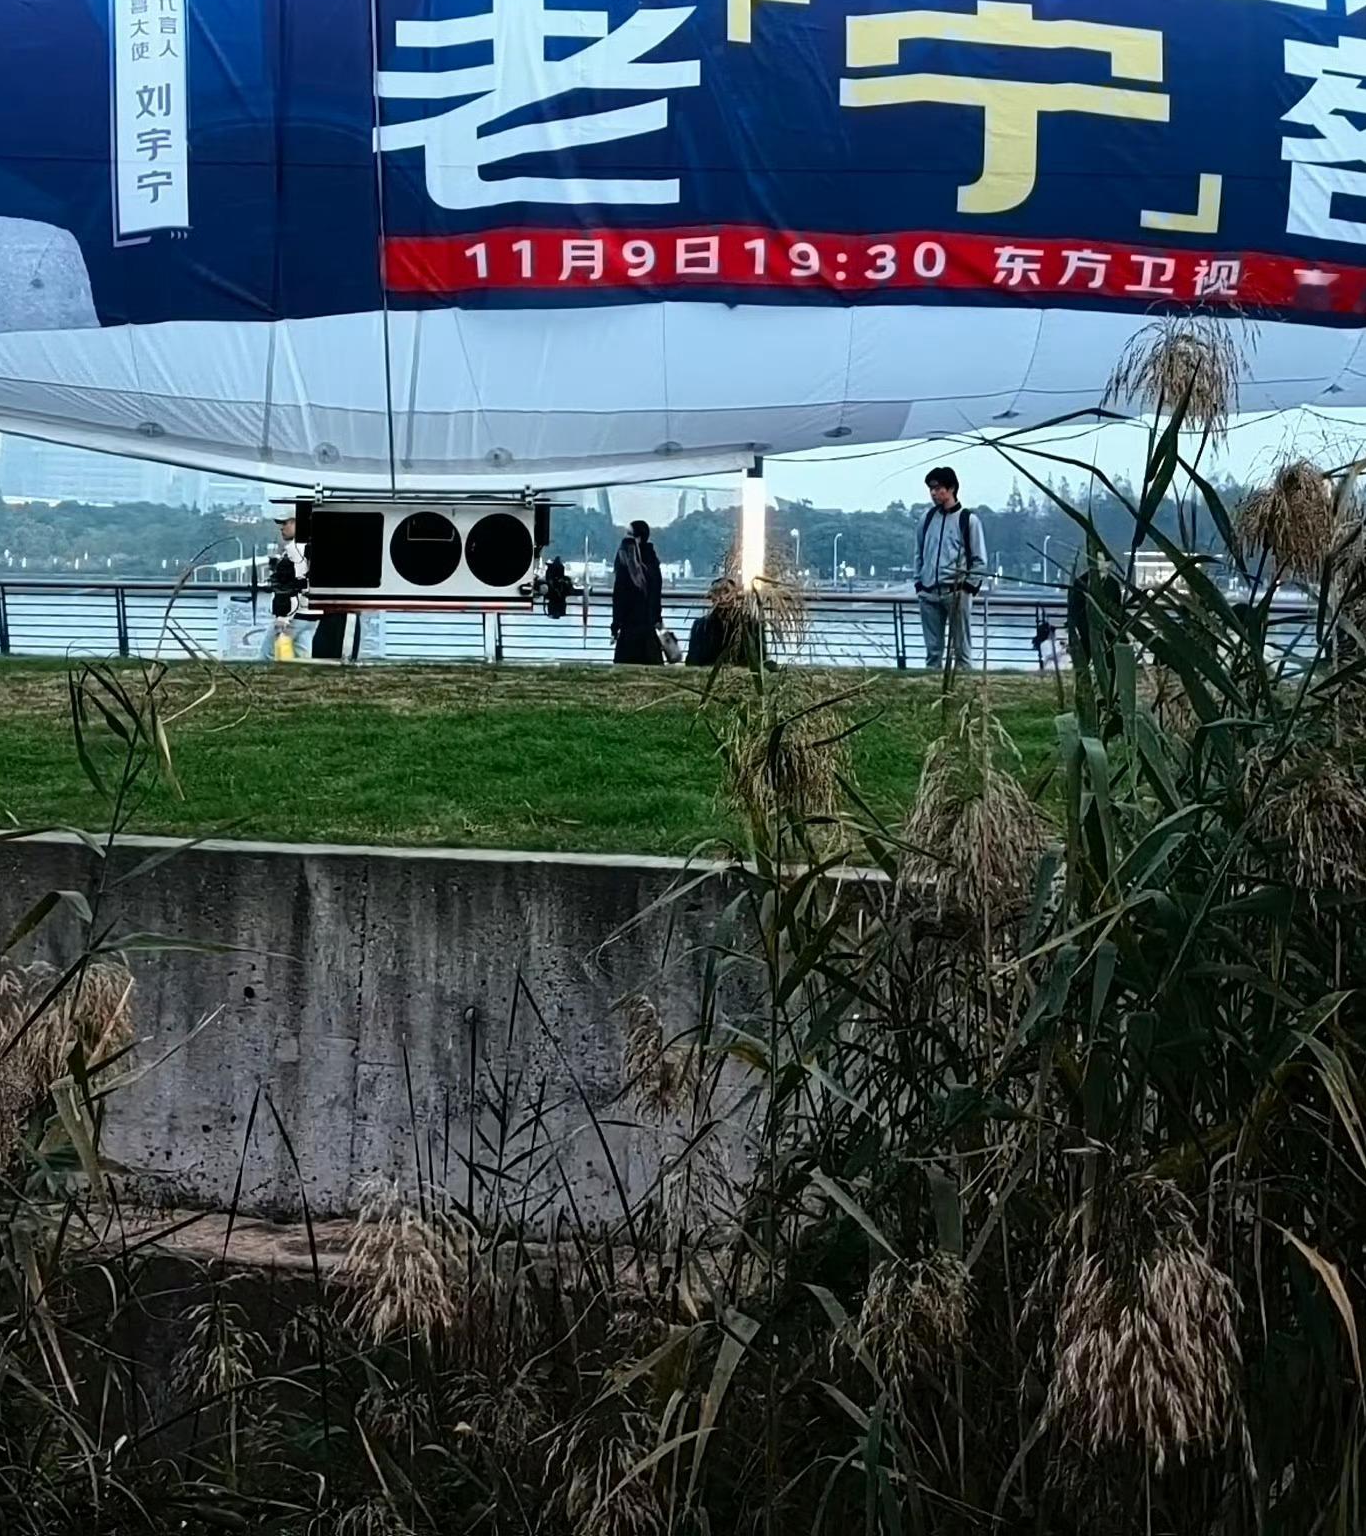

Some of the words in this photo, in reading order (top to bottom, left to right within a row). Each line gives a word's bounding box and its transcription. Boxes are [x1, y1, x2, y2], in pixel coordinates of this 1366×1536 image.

[135, 82, 173, 204] 刘宇宁
[992, 245, 1242, 297] 东方卫视
